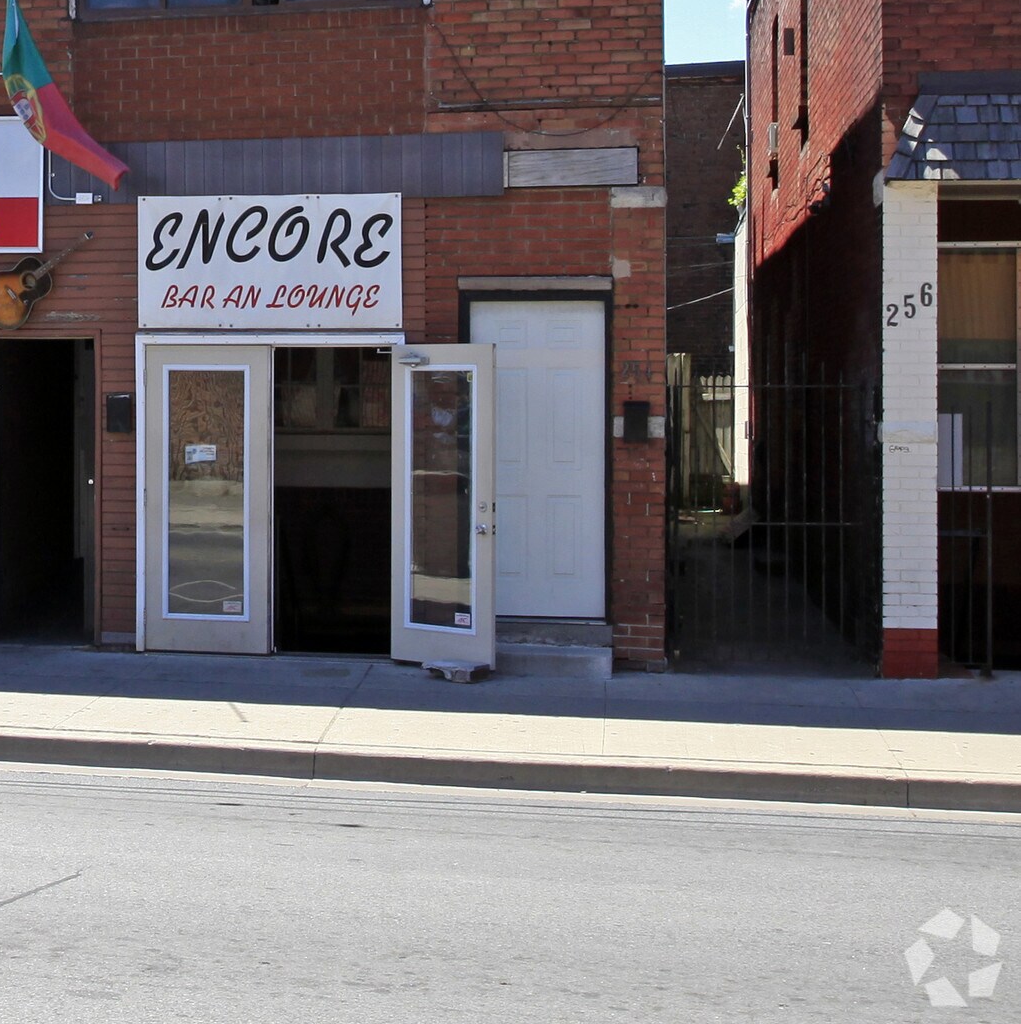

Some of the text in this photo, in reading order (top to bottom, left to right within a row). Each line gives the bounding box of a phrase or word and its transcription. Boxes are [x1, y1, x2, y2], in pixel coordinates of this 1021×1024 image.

[145, 205, 394, 271] ENCORE
[161, 284, 381, 316] BAR AN LOUNGE
[886, 282, 934, 327] 256
